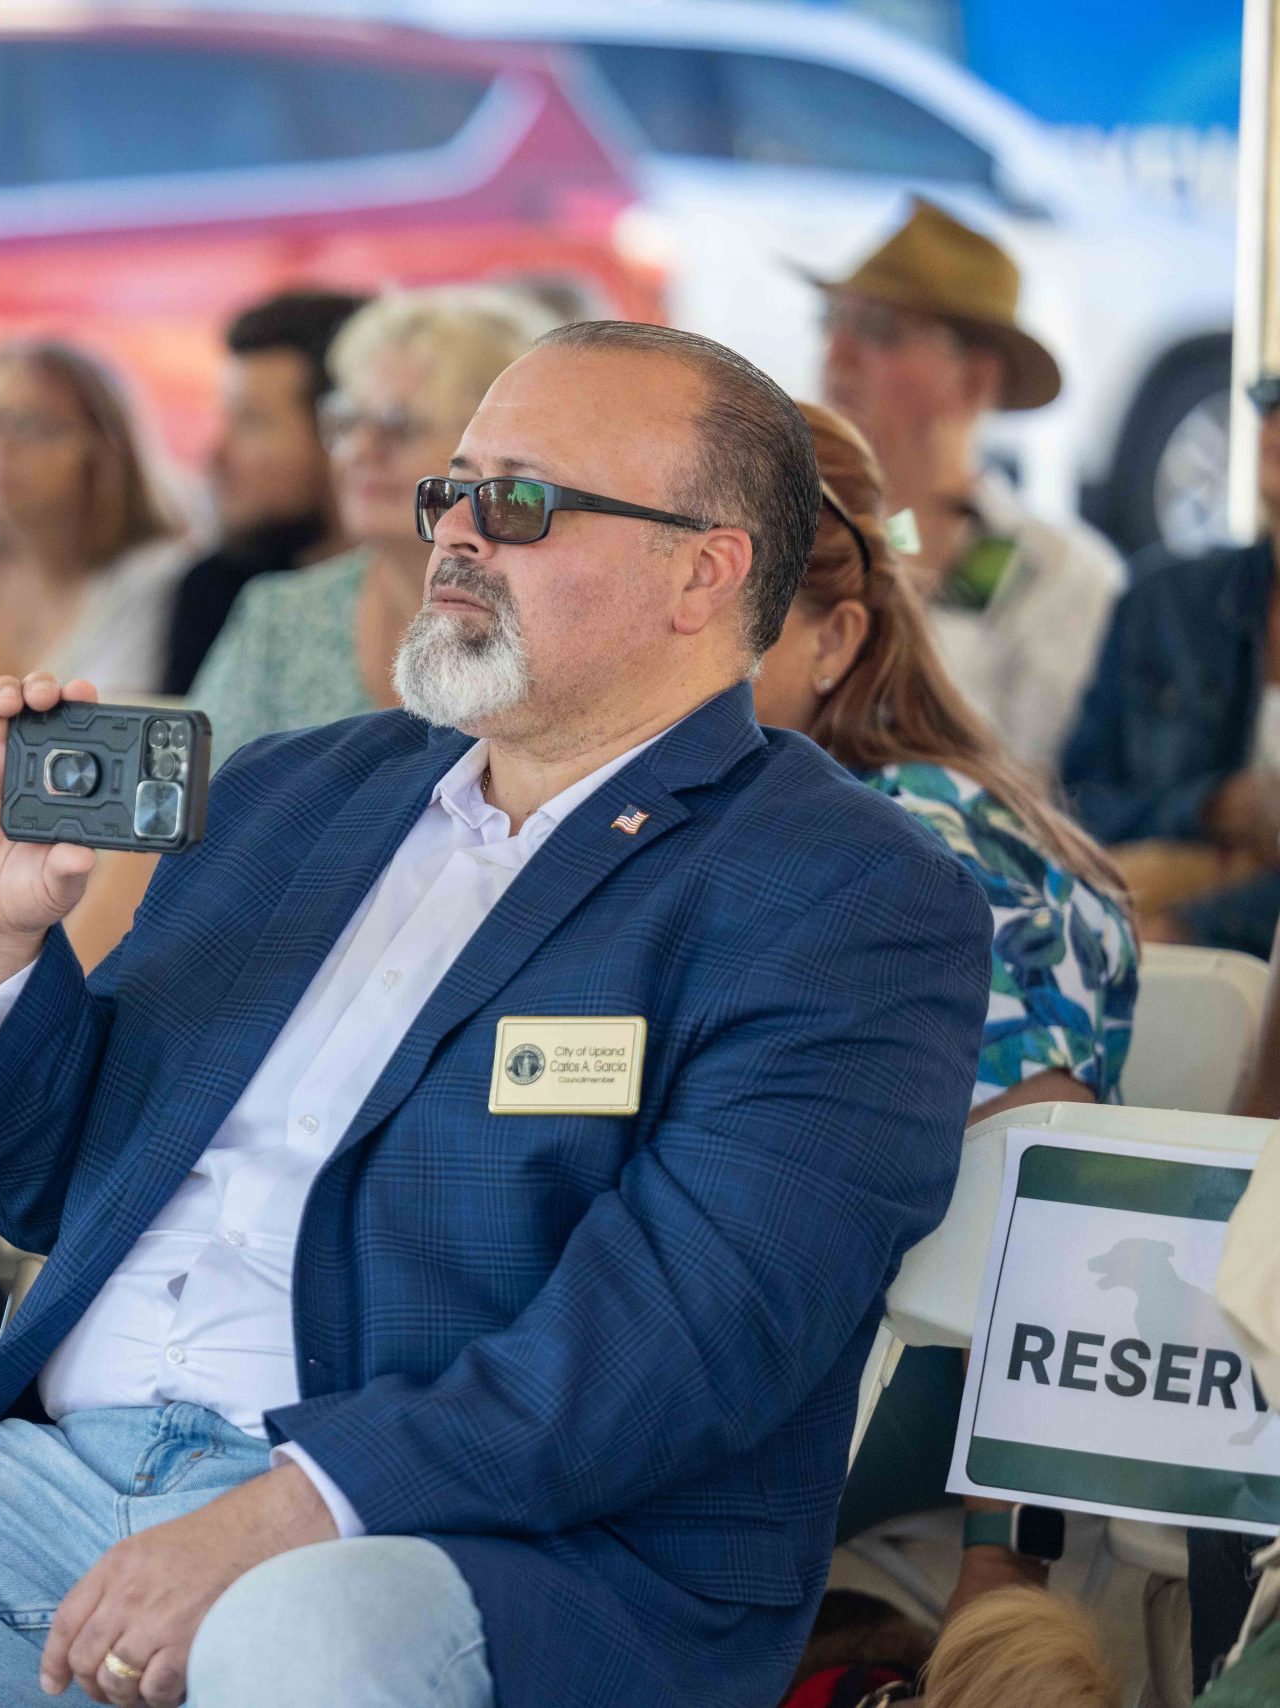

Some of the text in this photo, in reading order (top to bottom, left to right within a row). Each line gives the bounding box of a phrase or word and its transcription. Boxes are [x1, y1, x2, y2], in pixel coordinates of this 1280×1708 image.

[554, 1046, 626, 1058] City of Upland
[549, 1060, 580, 1073] Carlos
